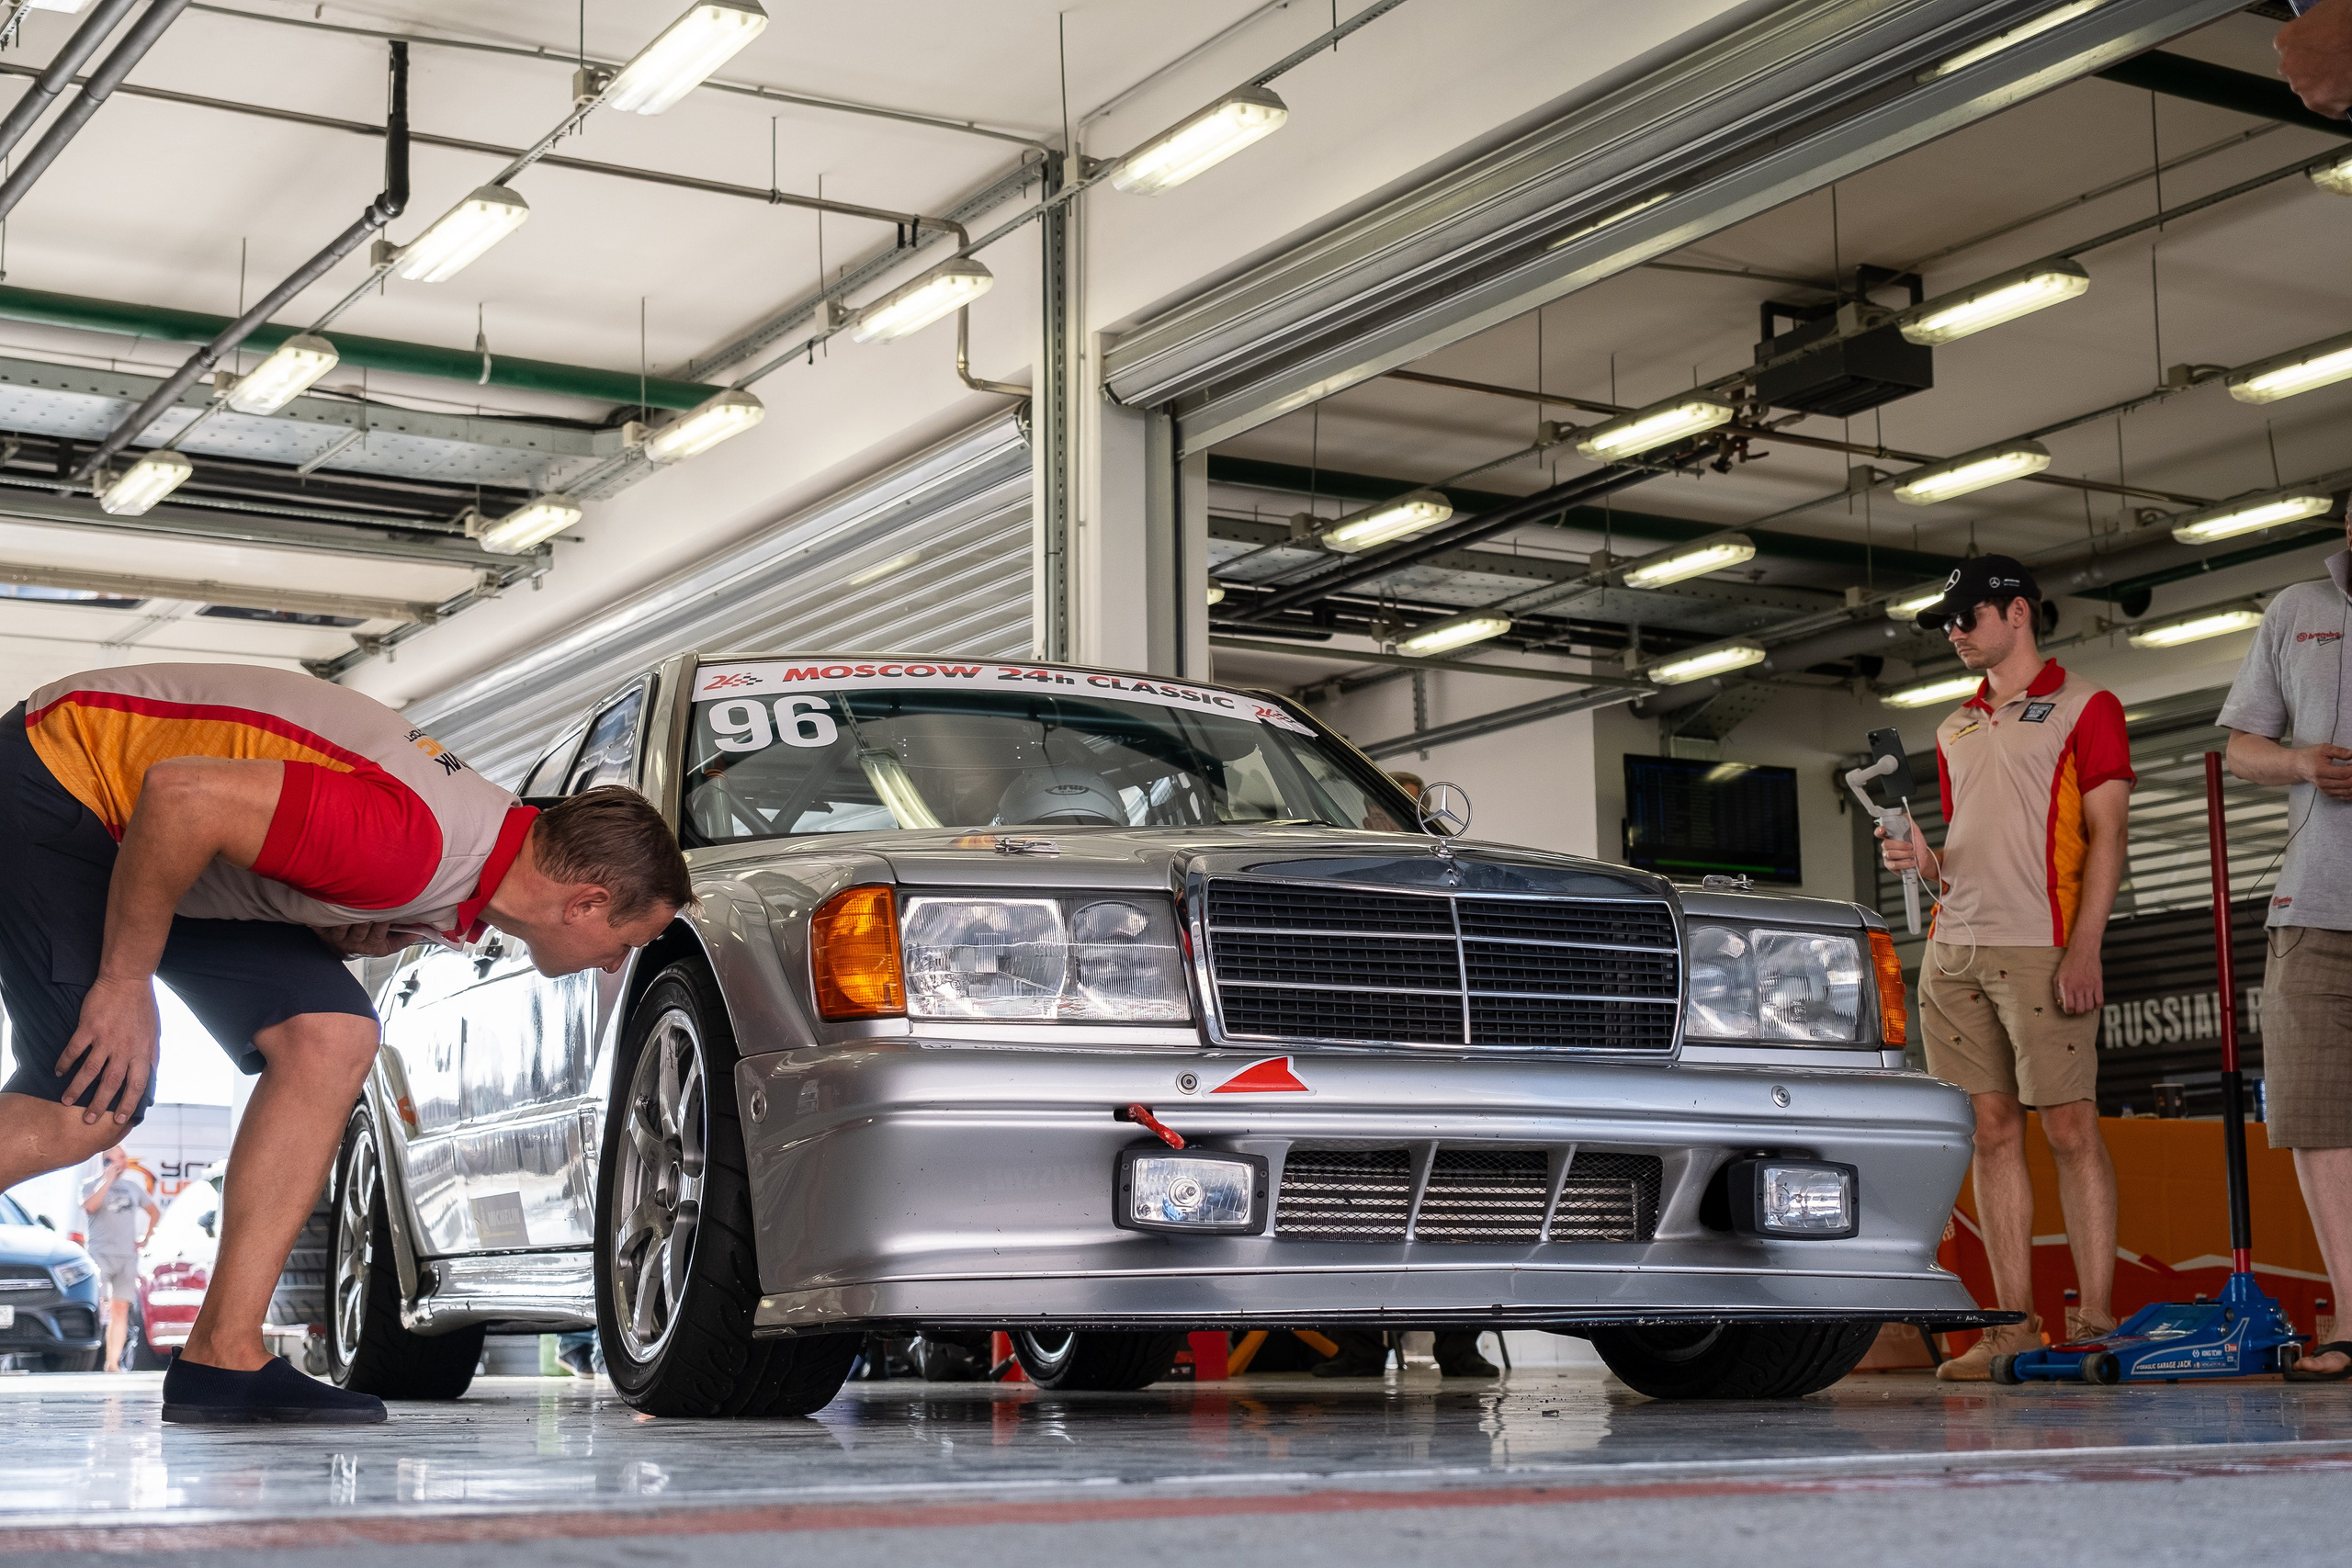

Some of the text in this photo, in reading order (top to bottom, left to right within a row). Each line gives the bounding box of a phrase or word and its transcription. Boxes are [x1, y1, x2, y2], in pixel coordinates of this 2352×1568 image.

[783, 665, 1235, 710] MOSCOW 24h CLASSIC
[708, 695, 838, 752] 96
[2156, 1361, 2177, 1370] GARAGE
[2177, 1360, 2192, 1369] JACK
